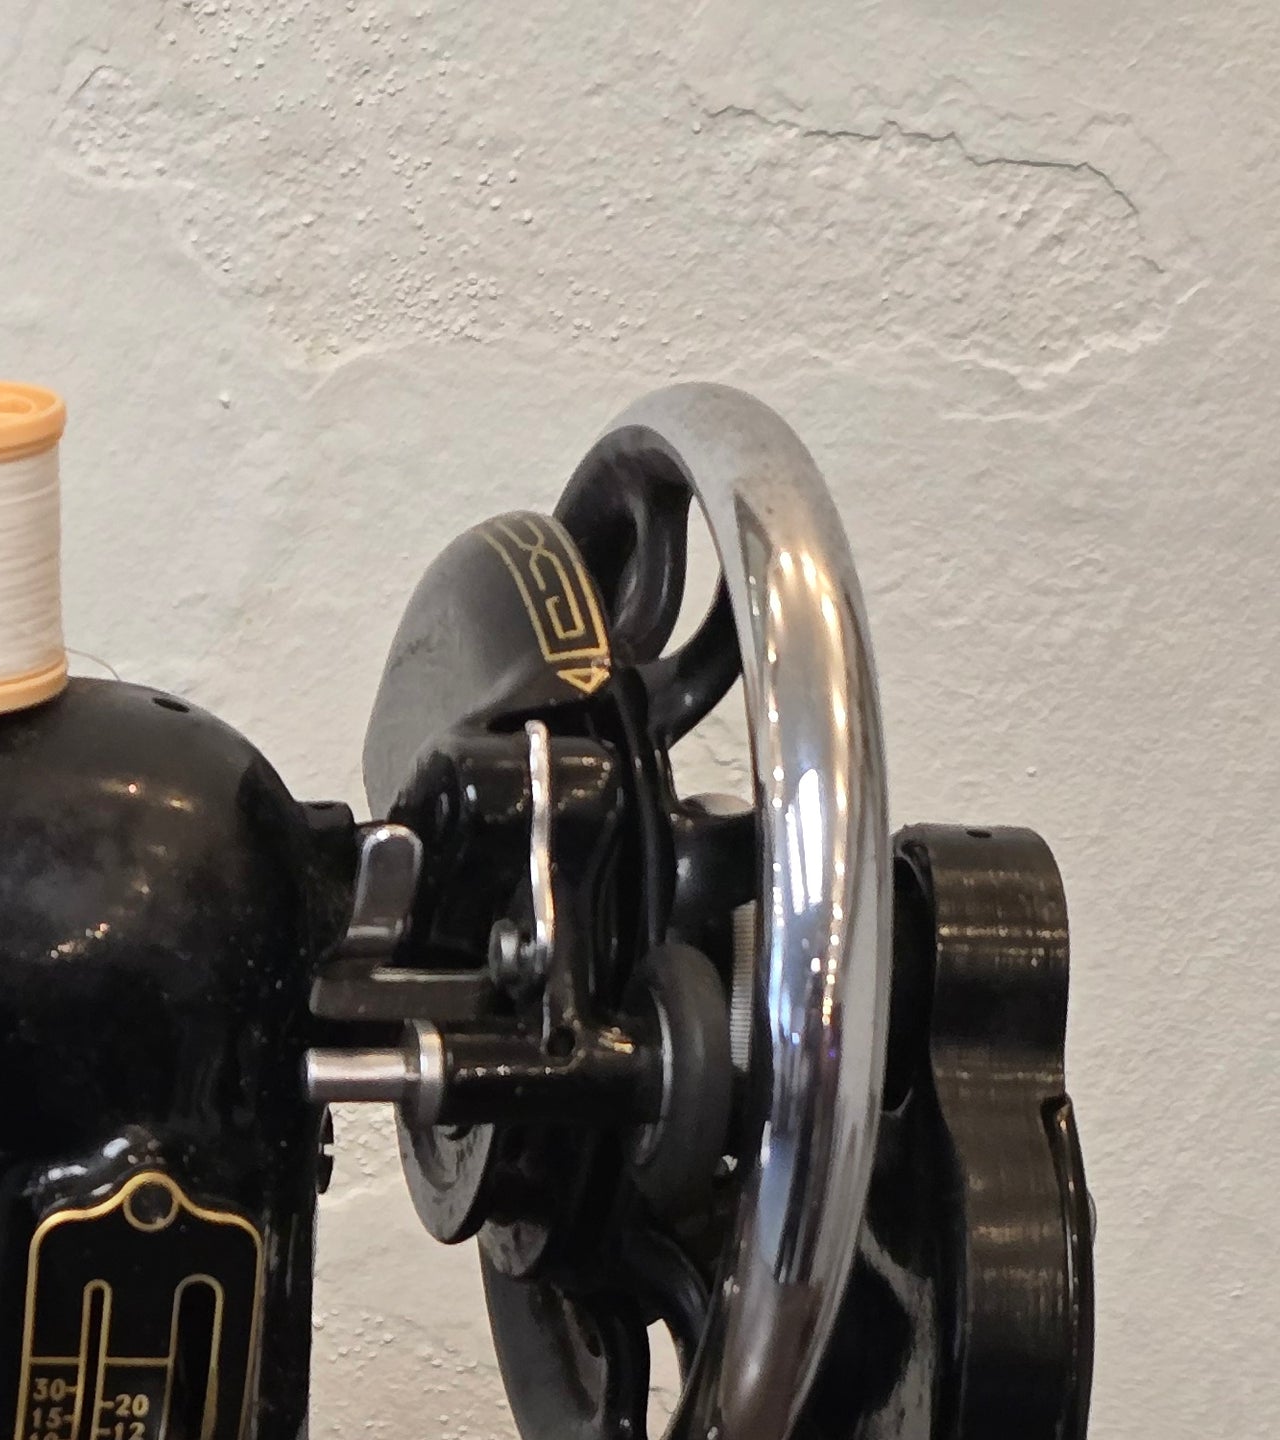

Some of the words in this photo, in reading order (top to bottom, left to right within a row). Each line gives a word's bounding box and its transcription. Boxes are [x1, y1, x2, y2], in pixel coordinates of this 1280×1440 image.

[32, 1378, 66, 1402] 30
[115, 1393, 150, 1418] 20
[32, 1406, 63, 1430] 15
